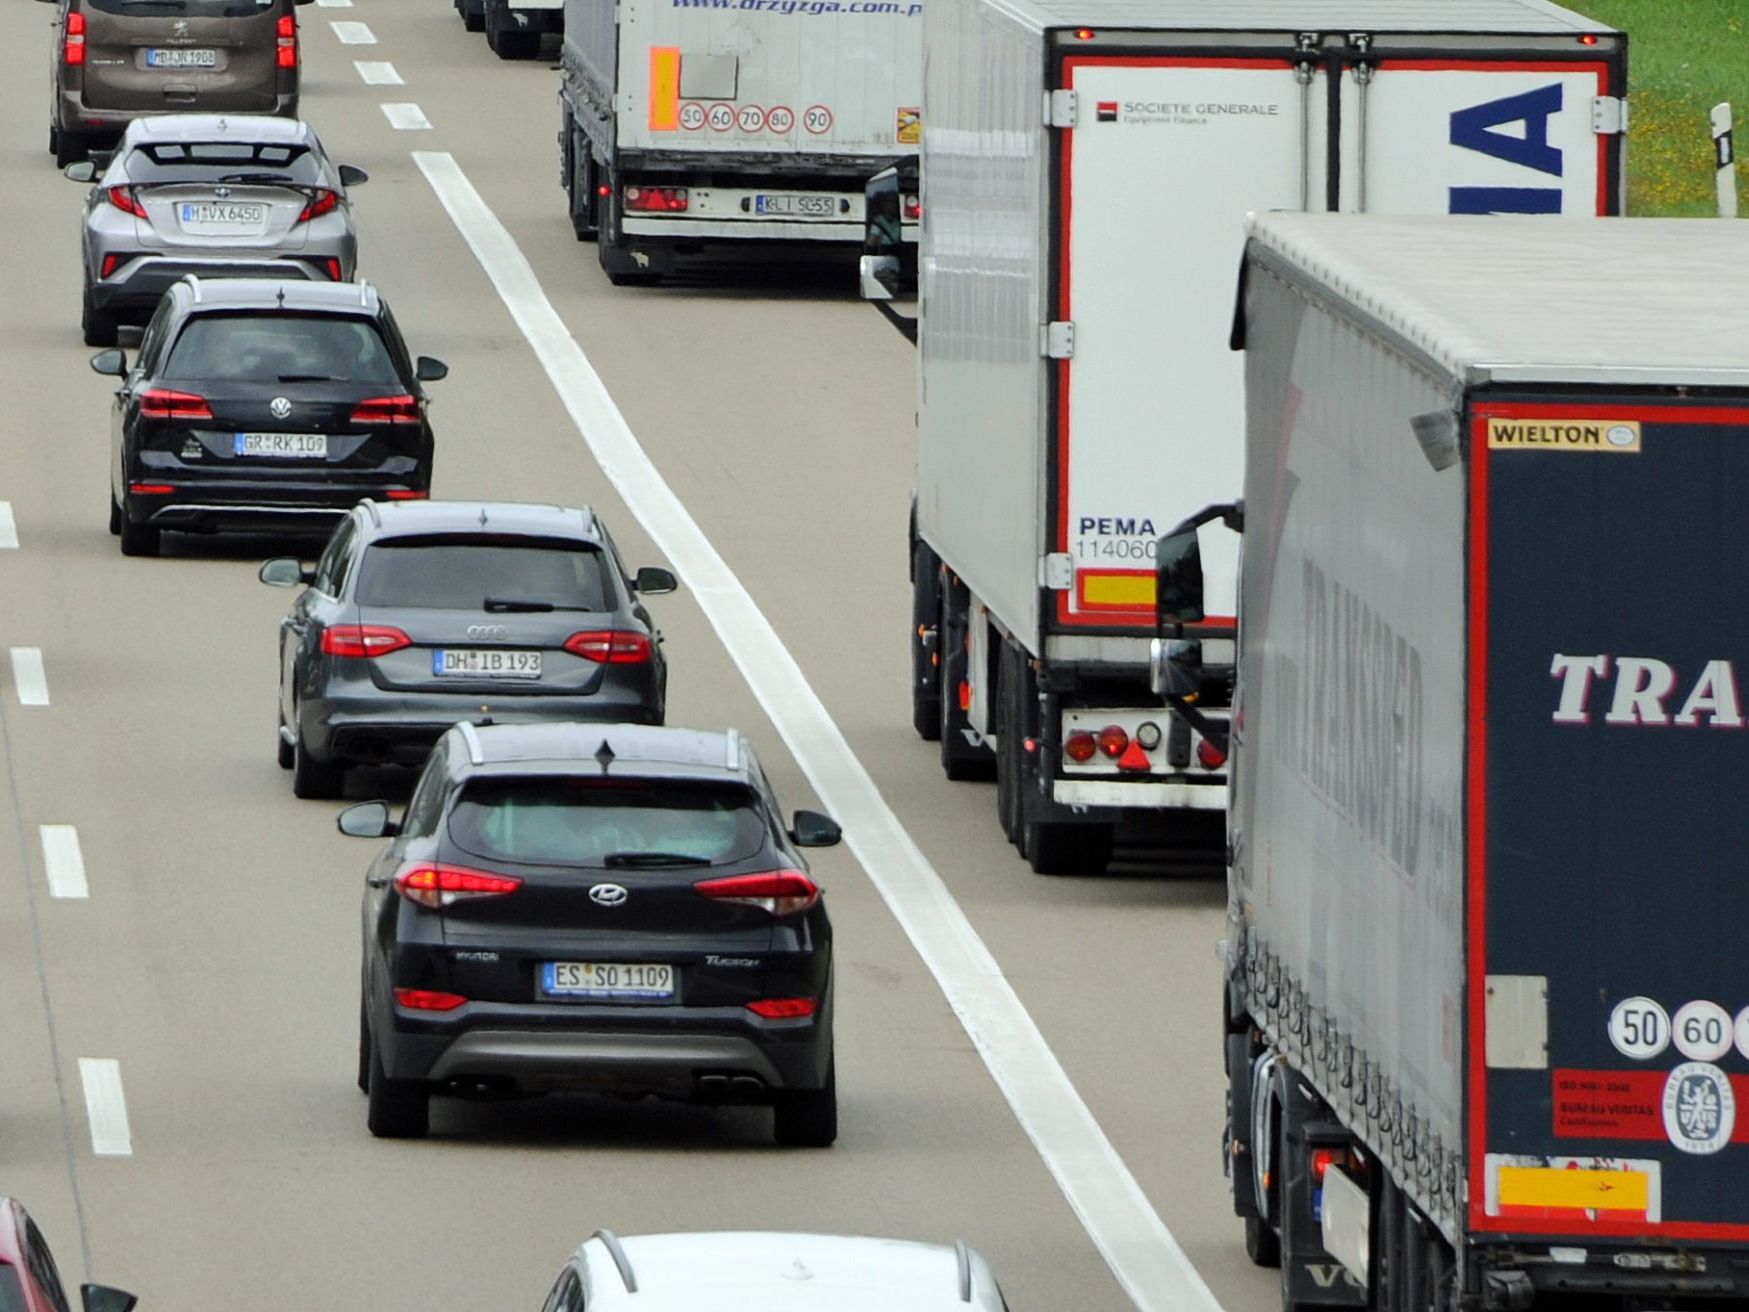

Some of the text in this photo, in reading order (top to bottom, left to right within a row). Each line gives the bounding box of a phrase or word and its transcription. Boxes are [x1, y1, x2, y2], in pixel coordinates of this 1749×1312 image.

[683, 110, 702, 123] 50
[711, 111, 730, 125] 60
[1124, 102, 1278, 116] SOCIETE GENERALE
[742, 112, 760, 126] 70
[771, 113, 788, 126] 80
[809, 112, 826, 127] 90
[244, 433, 324, 452] GR RK 109
[1493, 425, 1600, 445] WIELTON
[1080, 517, 1156, 536] PEMA
[1076, 539, 1156, 559] 114060
[446, 653, 540, 671] DH IB 193
[1550, 653, 1747, 727] TRA
[555, 966, 670, 987] ES SO 1109
[1623, 1010, 1658, 1046] 50
[1684, 1017, 1721, 1045] 60
